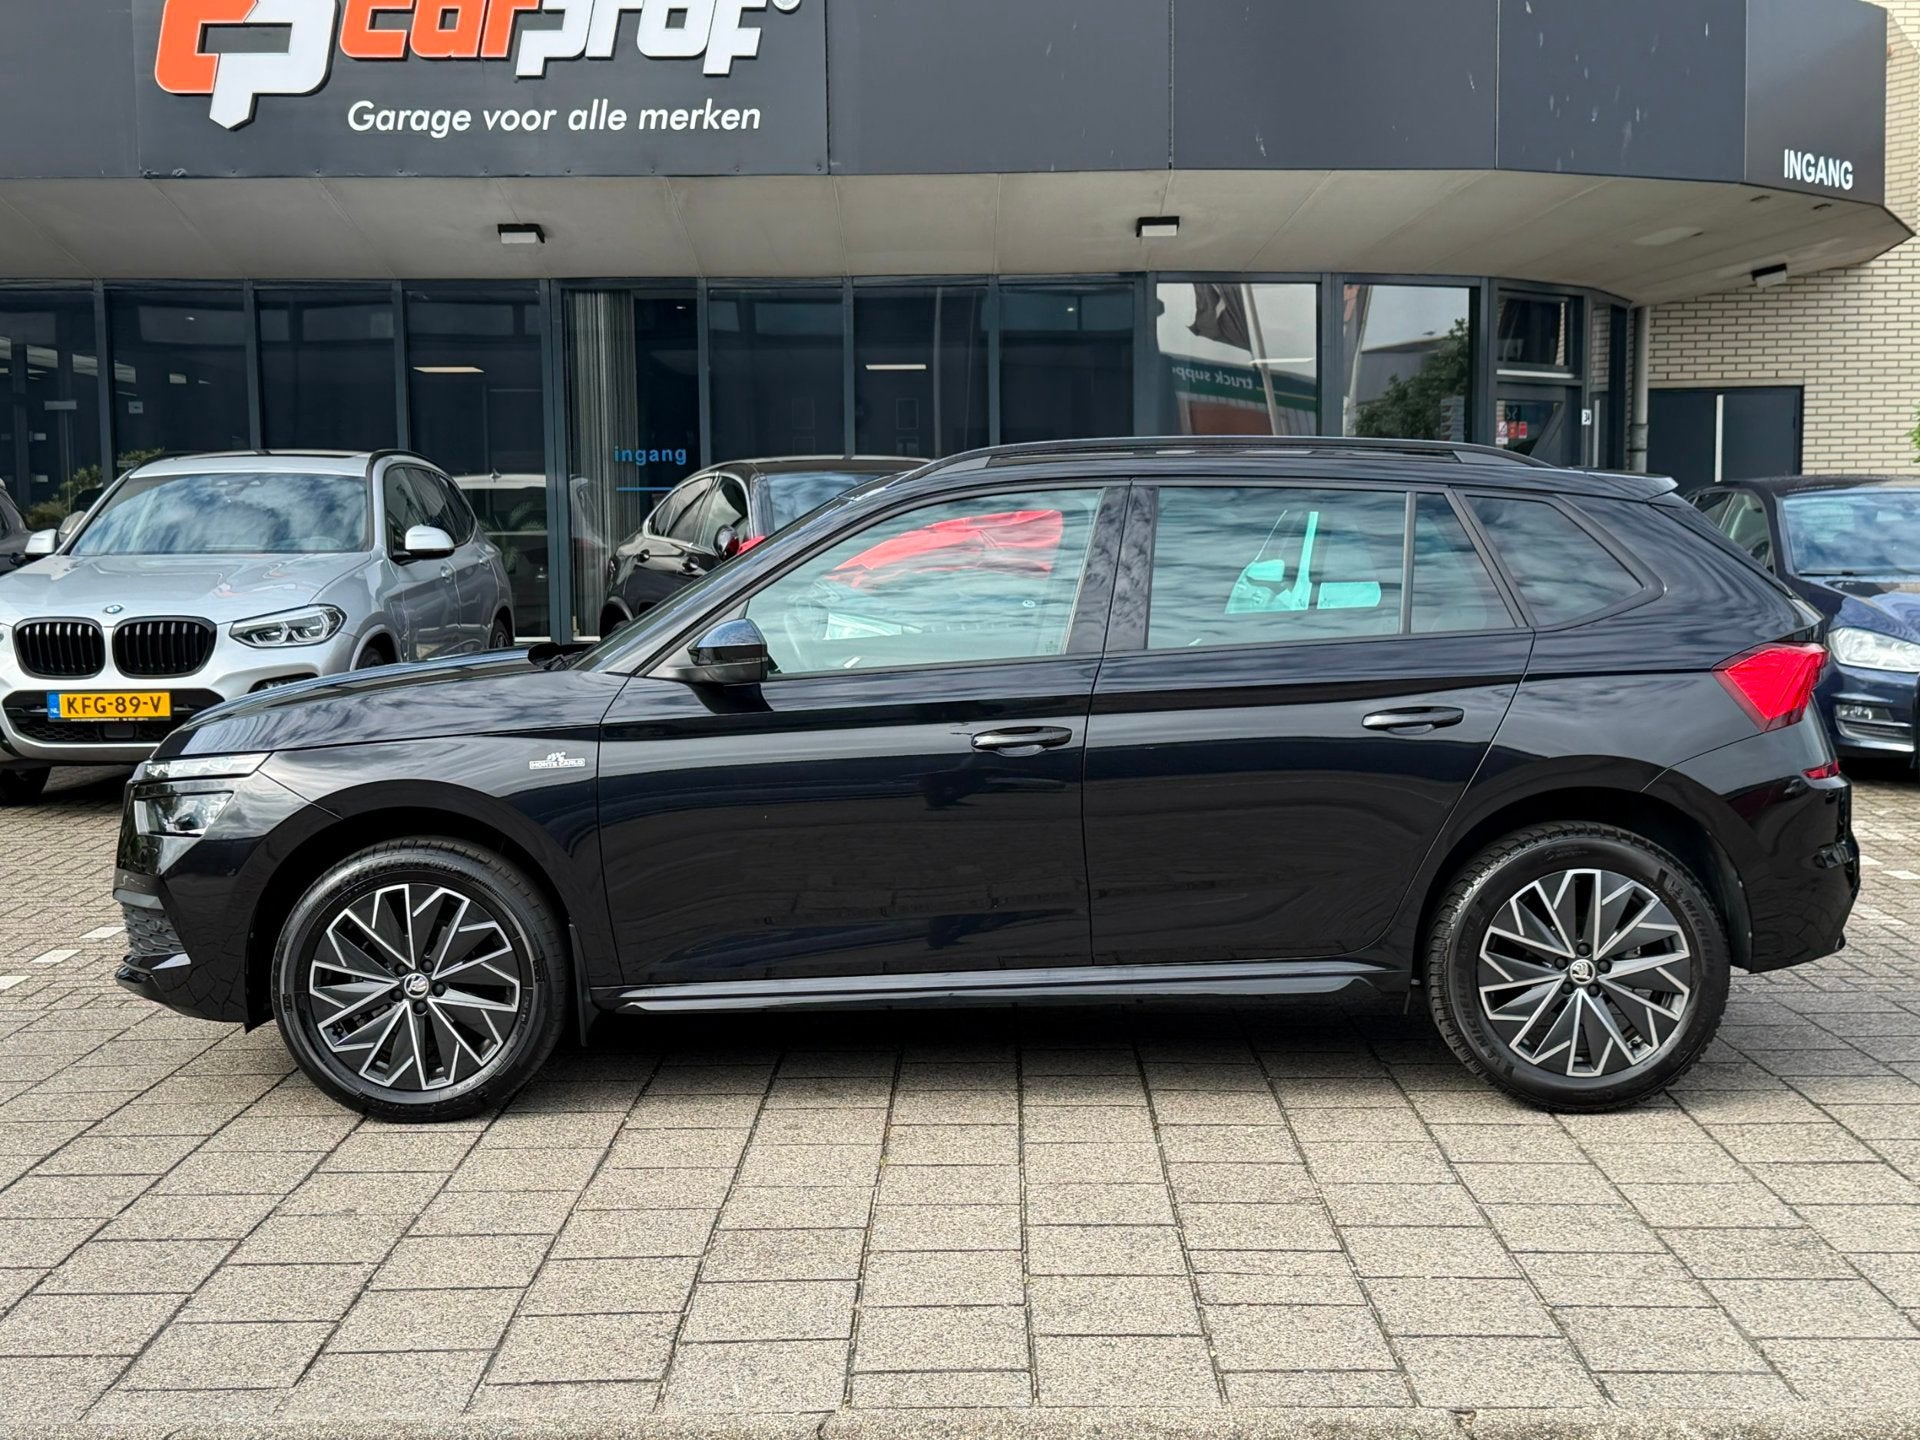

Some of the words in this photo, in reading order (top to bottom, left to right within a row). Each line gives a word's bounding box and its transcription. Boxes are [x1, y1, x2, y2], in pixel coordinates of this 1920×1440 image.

[347, 100, 471, 138] Garage
[483, 109, 556, 131] voor
[568, 98, 627, 131] alle
[638, 98, 761, 131] merken
[1783, 148, 1853, 190] INGANG
[614, 445, 687, 466] ingang
[66, 696, 161, 714] KFG-89-V
[559, 759, 584, 767] CARLO
